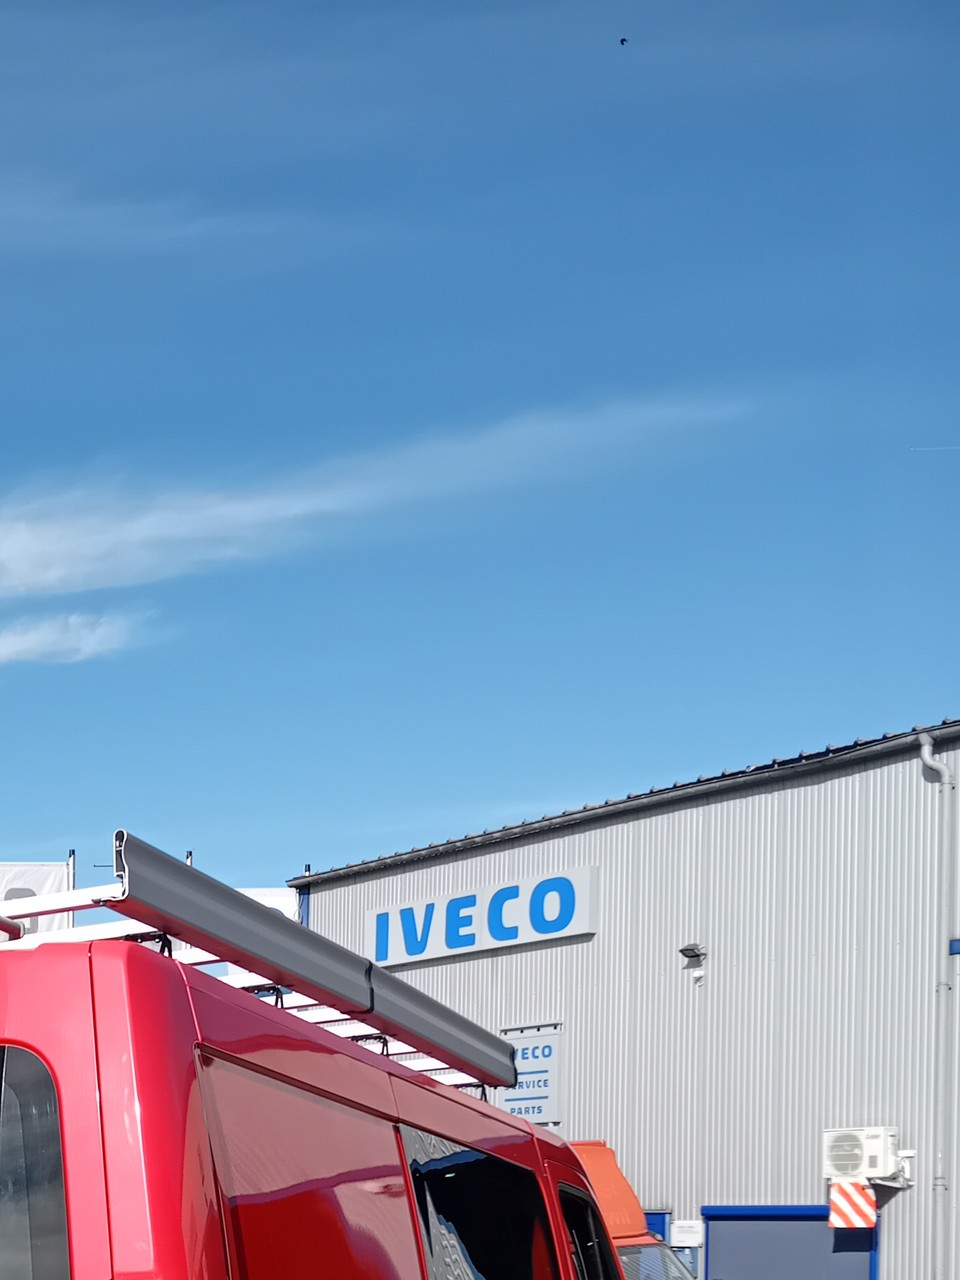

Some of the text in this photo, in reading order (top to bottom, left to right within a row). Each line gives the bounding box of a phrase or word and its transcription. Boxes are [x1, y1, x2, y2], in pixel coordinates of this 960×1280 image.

[375, 877, 576, 962] IVECO
[514, 1045, 552, 1060] ECO
[505, 1079, 549, 1090] RVICE
[510, 1106, 543, 1115] PARTS
